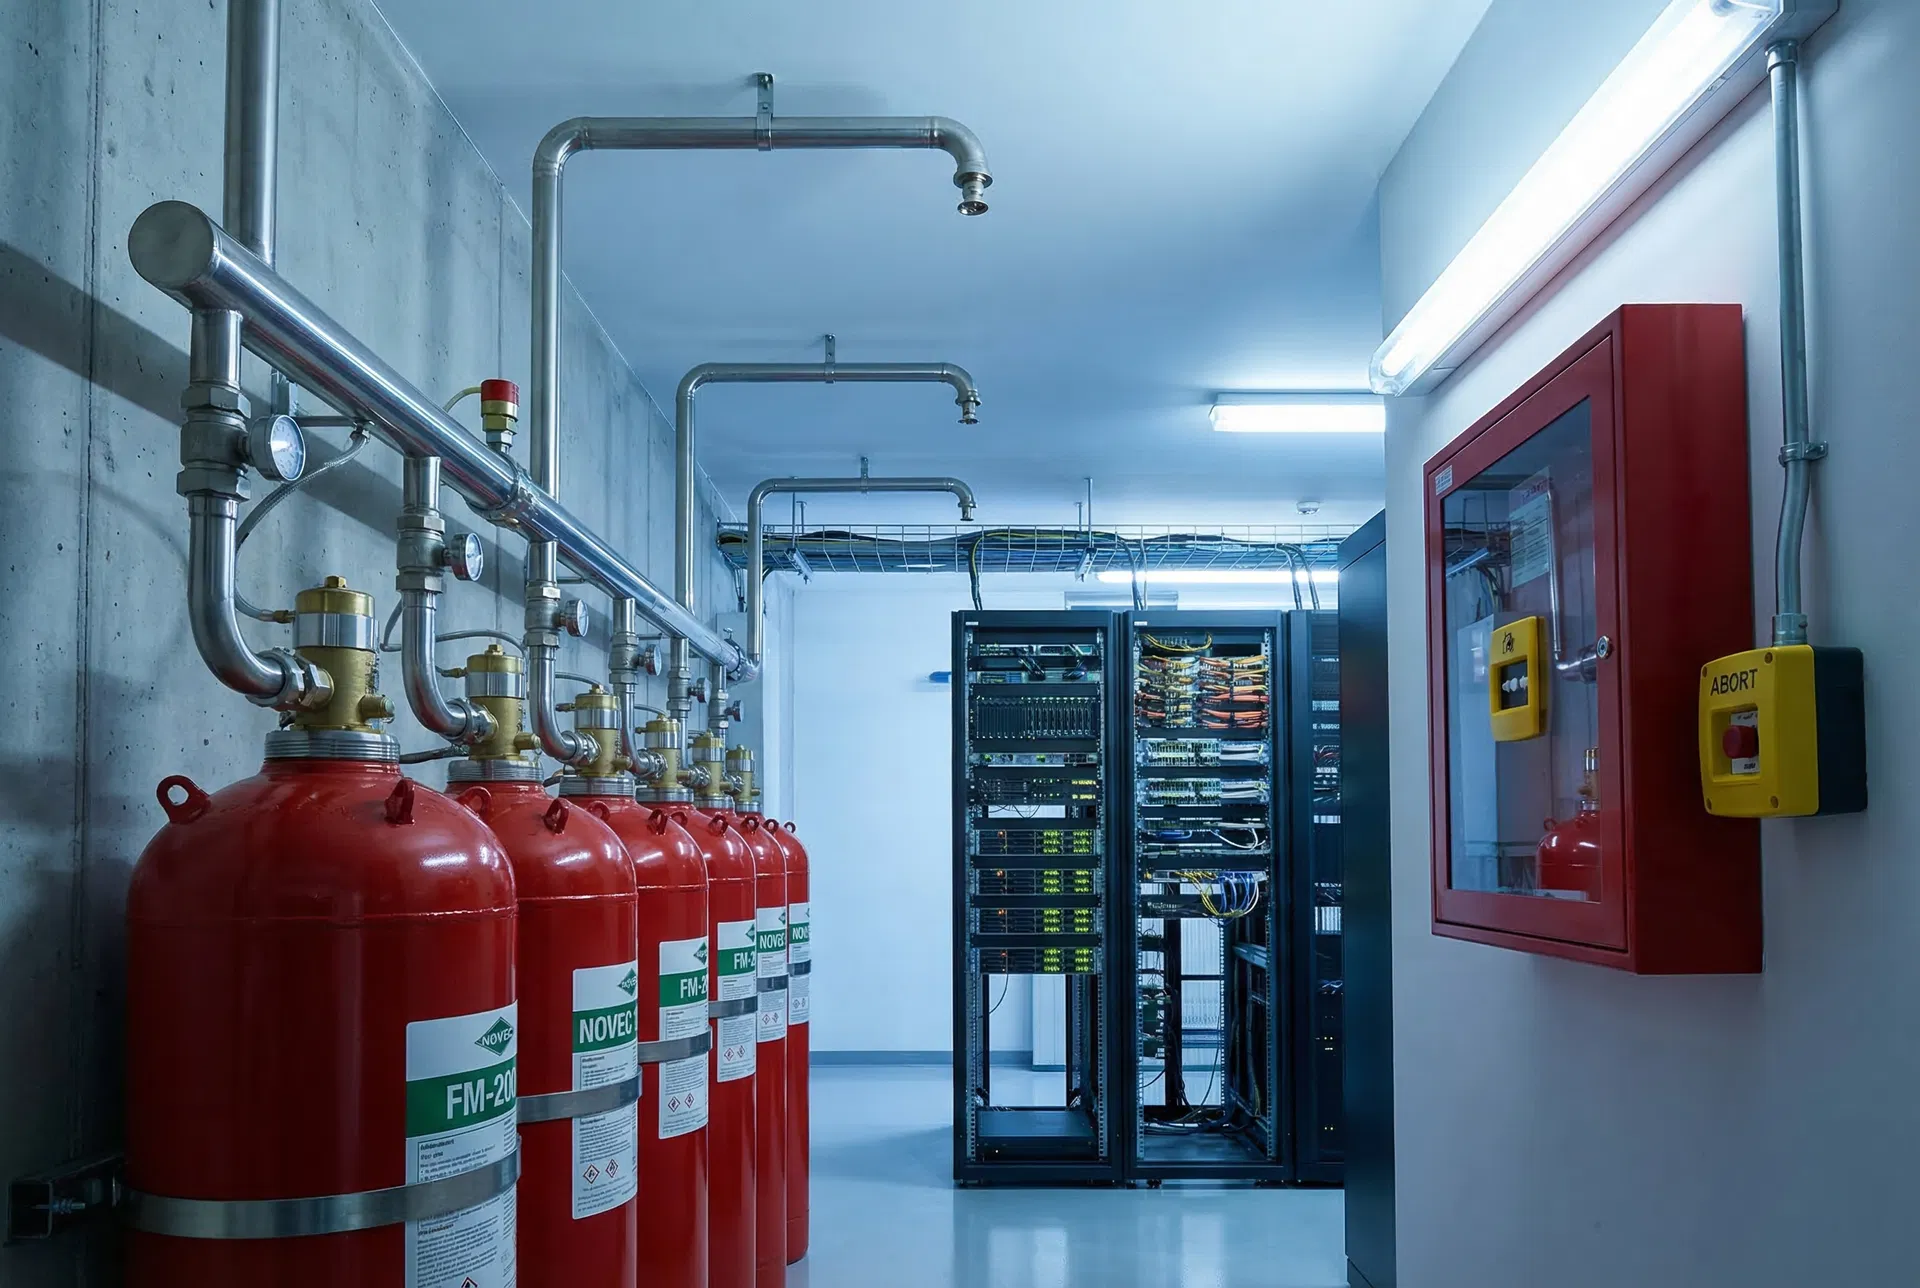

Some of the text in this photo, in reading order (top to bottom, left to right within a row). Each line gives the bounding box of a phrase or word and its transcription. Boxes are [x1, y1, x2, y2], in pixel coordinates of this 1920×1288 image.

[1710, 669, 1758, 696] ABORT
[481, 1027, 513, 1046] NOVEC
[579, 1010, 632, 1044] NOVEC
[446, 1066, 517, 1120] FM-200
